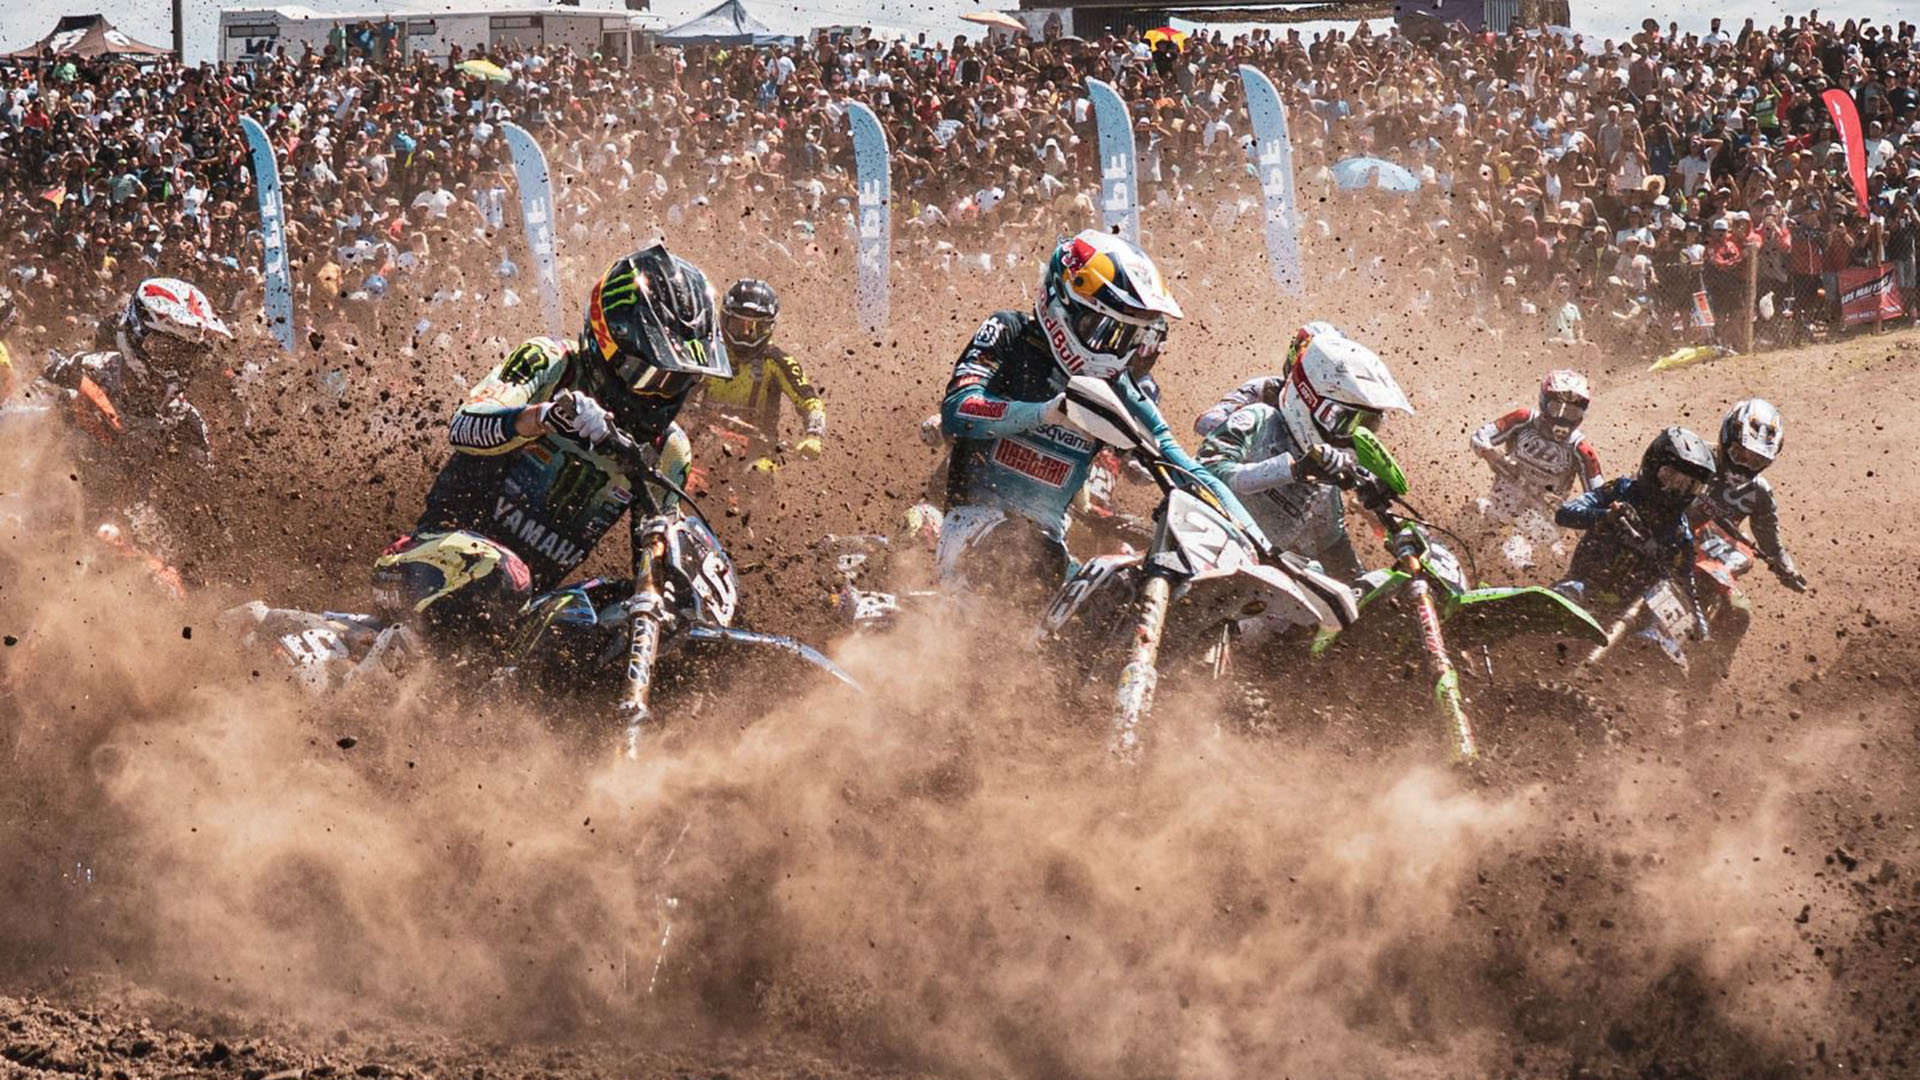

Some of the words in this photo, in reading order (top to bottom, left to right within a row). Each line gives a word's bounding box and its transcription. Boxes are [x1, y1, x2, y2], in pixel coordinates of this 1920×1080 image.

[1052, 328, 1085, 373] Bull
[450, 414, 508, 447] AMAHA
[1035, 423, 1093, 453] sqvarn
[493, 495, 586, 568] YAMAHA
